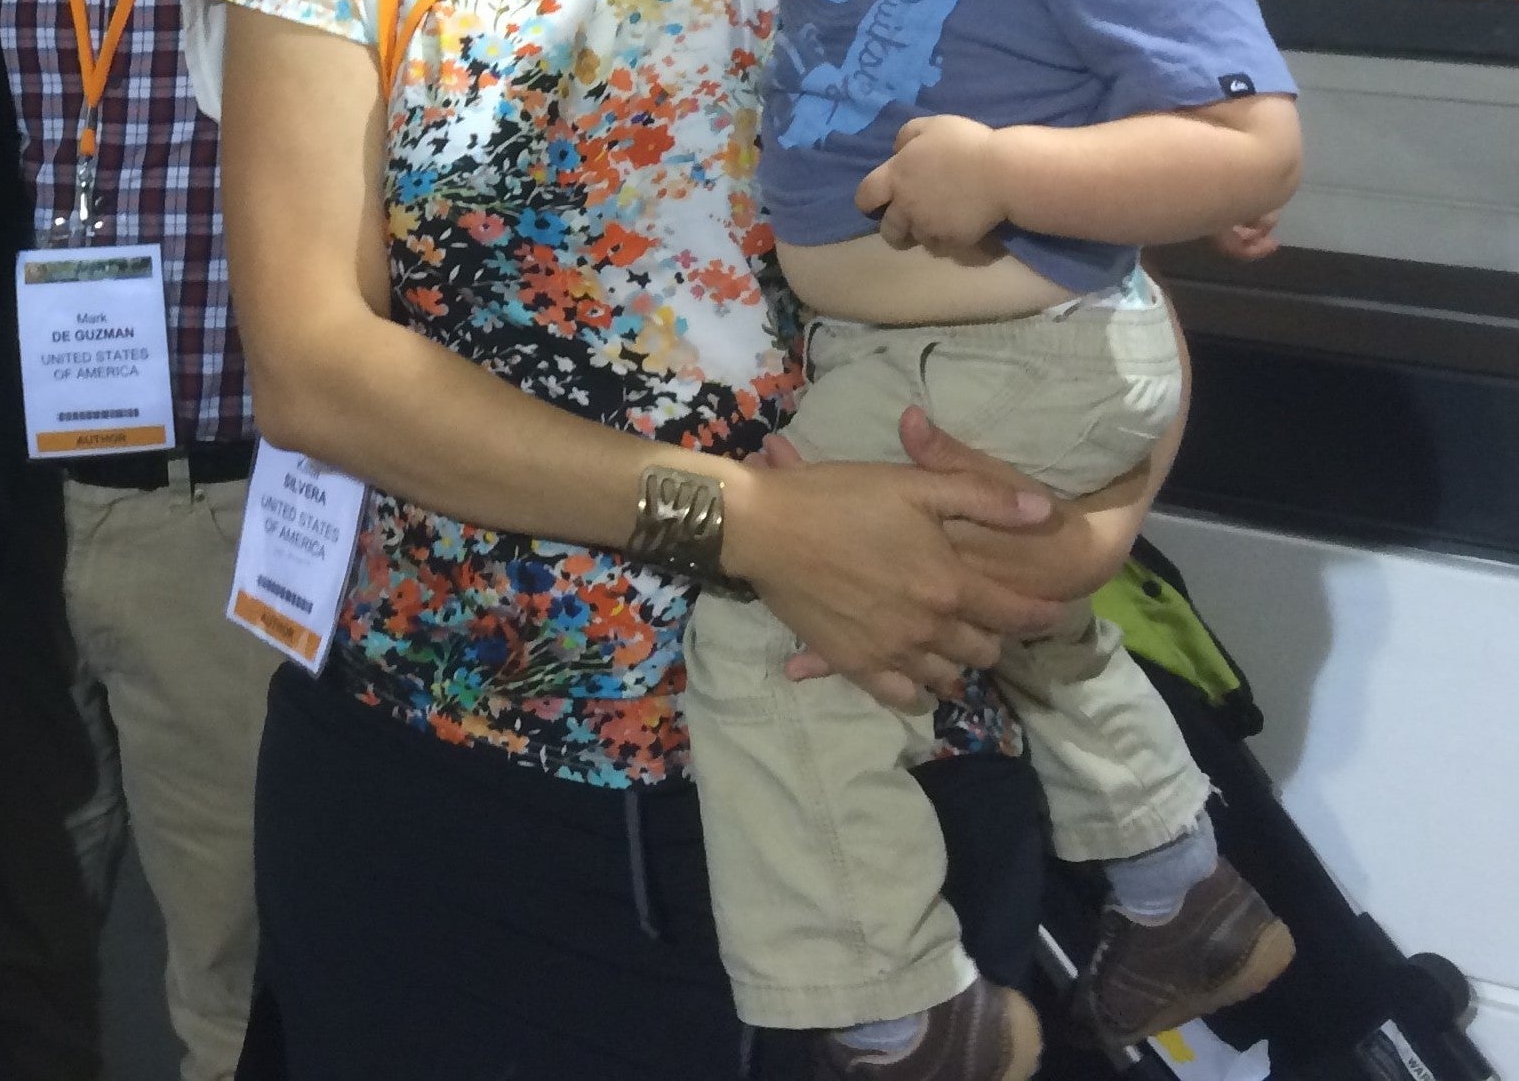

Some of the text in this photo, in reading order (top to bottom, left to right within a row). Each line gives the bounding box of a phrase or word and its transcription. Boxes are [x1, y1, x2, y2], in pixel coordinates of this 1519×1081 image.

[52, 328, 134, 342] DE GUZMAN
[41, 348, 149, 365] UNITED STATES
[54, 365, 139, 380] OF AMERICA
[76, 434, 127, 445] AUTHOR
[284, 473, 326, 506] SILVERA
[261, 493, 340, 543] UNITED STATES
[264, 518, 278, 533] OF
[279, 525, 325, 560] AMERICA
